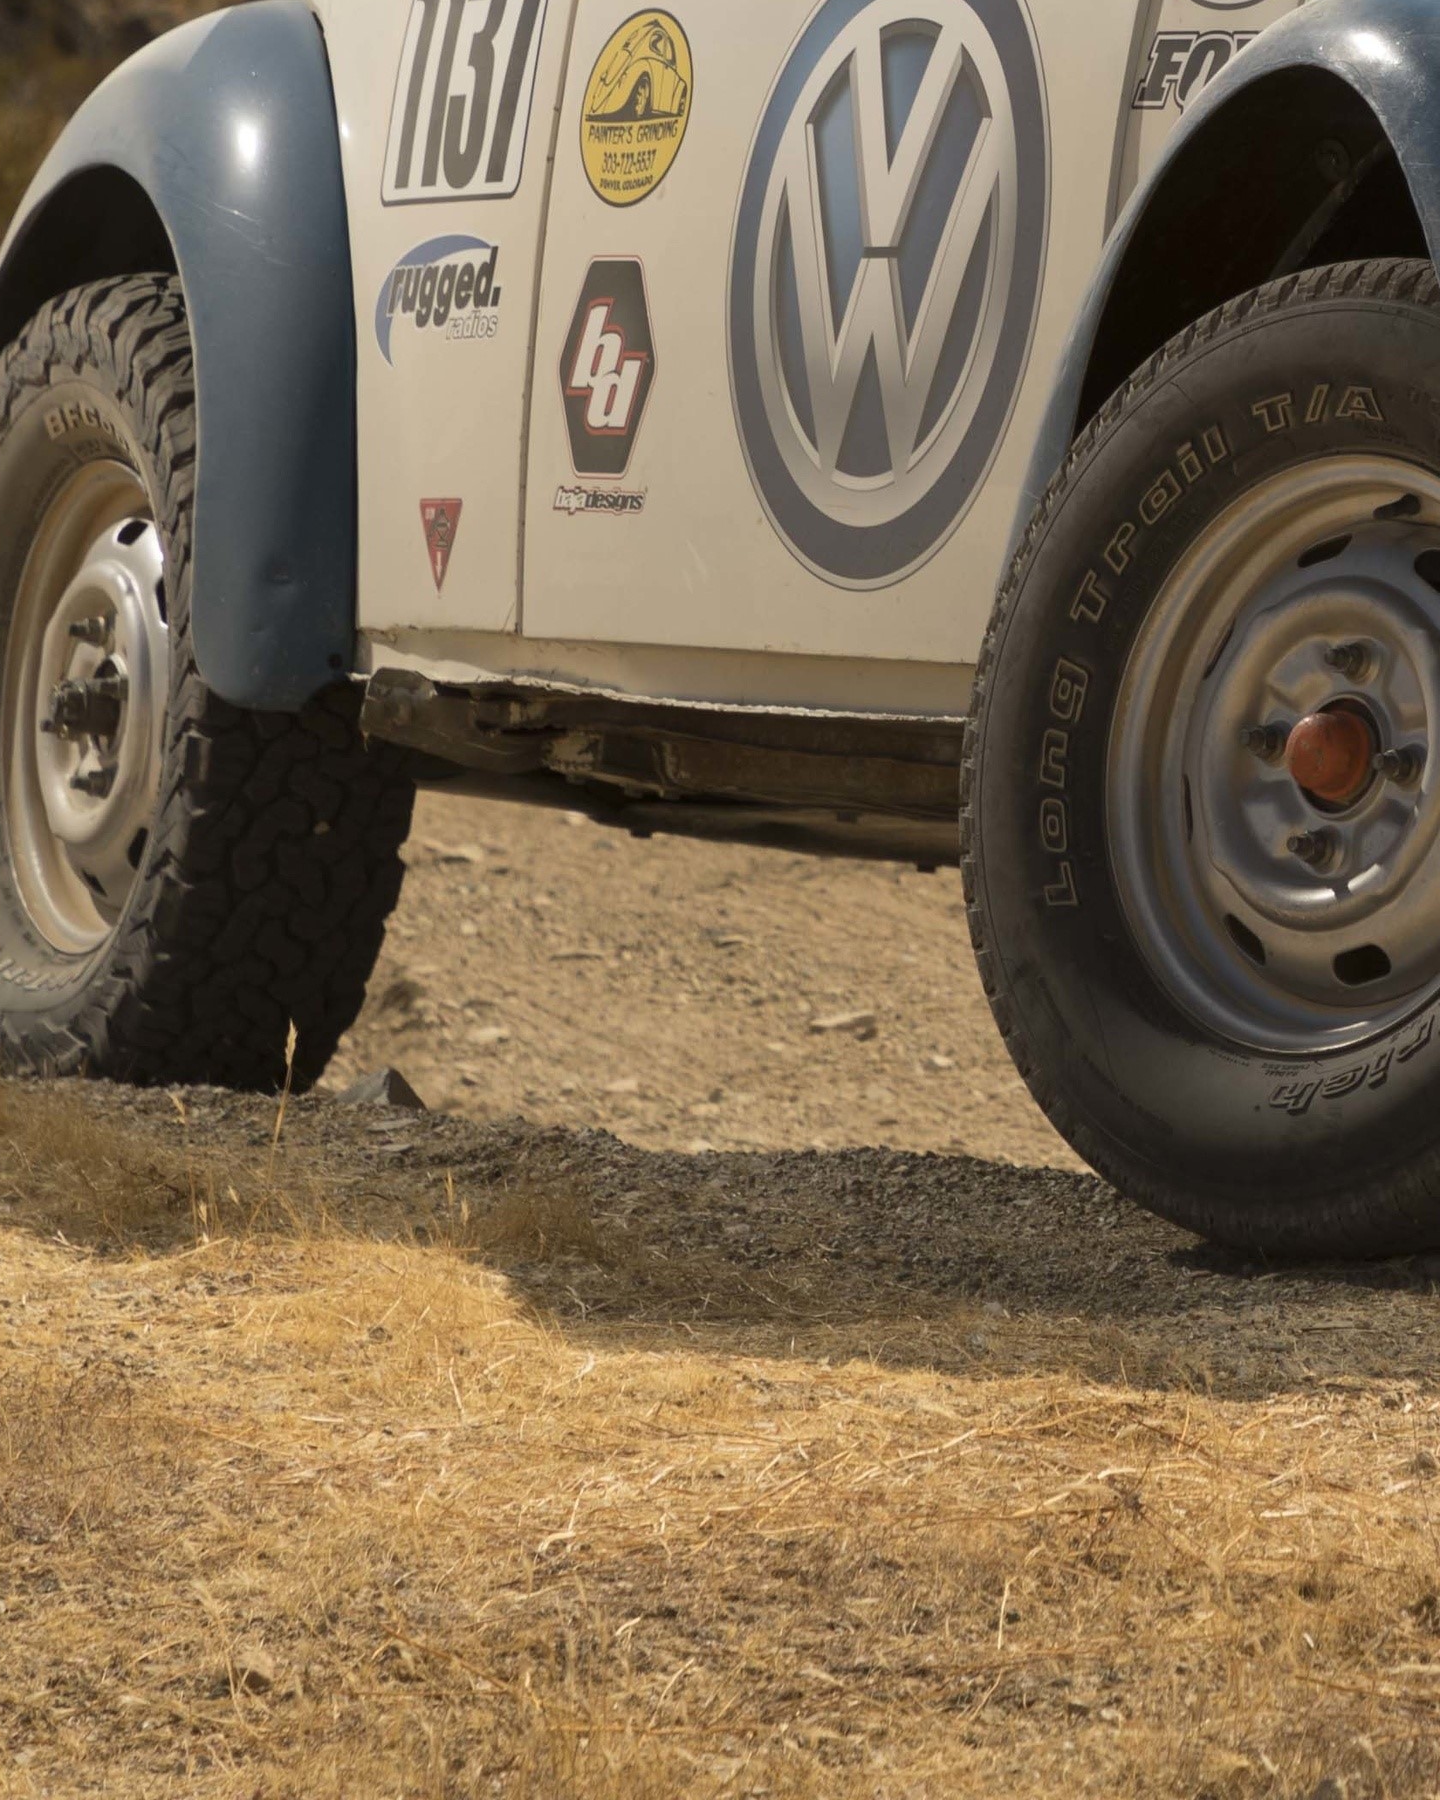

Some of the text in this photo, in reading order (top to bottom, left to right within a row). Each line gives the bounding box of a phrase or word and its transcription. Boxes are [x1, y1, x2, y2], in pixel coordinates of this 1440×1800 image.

[1133, 30, 1260, 114] FO
[588, 119, 679, 145] PAINTER'S GRINDING
[445, 308, 499, 340] radios
[570, 299, 645, 433] bd
[1252, 383, 1385, 434] T/A
